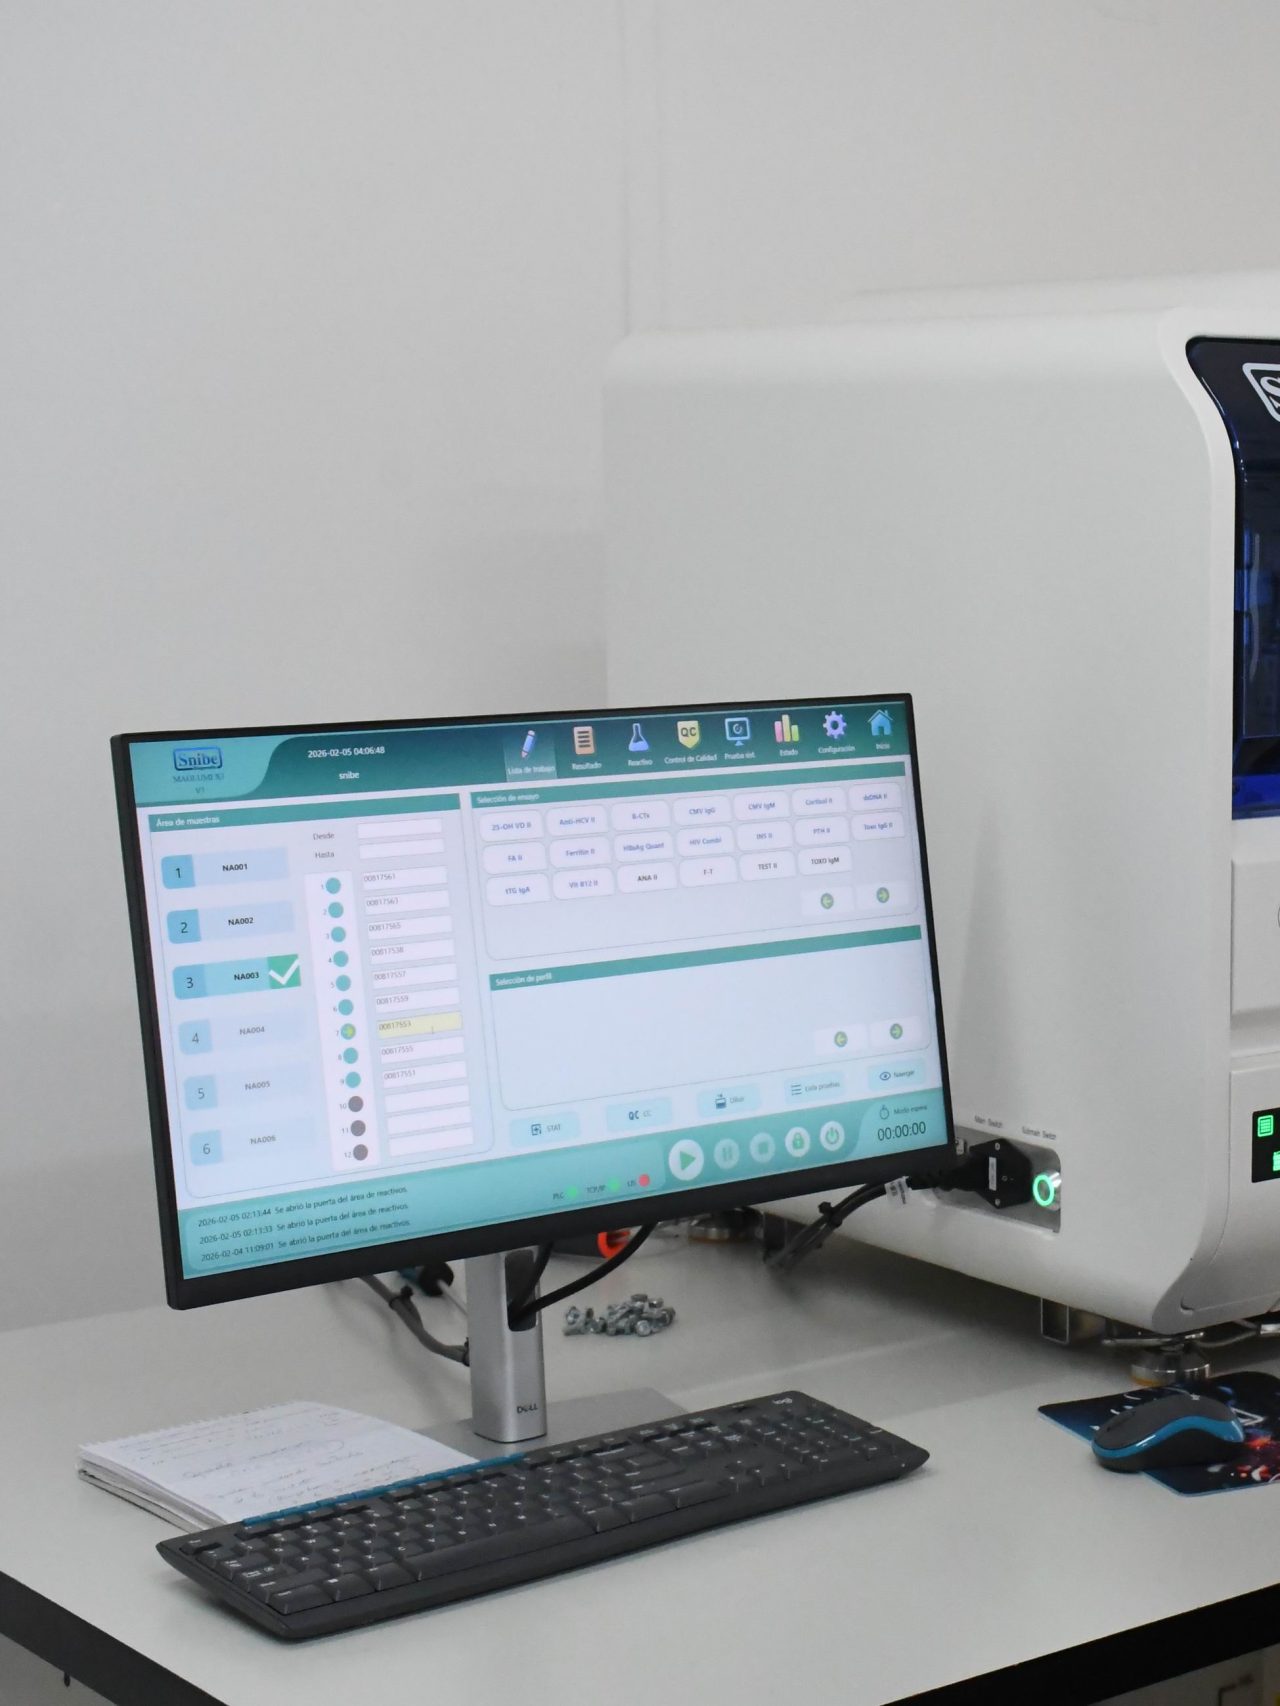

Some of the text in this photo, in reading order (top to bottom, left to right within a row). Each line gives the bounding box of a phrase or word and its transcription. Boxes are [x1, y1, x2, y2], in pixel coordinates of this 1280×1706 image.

[680, 727, 697, 737] QC
[308, 746, 385, 758] 2026-02-05 04:06:48
[178, 749, 219, 768] Snibe
[664, 756, 685, 764] Control
[695, 753, 718, 762] Calidad
[339, 770, 360, 780] snibe
[477, 794, 507, 804] Selección
[805, 797, 828, 806] Cortisol
[748, 802, 776, 811] CMV IgM
[156, 816, 220, 828] Área de muestras
[515, 822, 526, 830] VD
[559, 817, 590, 826] Anti-HCV
[313, 832, 335, 840] Desde
[689, 836, 722, 846] HIV Combi
[175, 863, 248, 878] 1 NA001
[758, 863, 772, 871] TEST
[363, 873, 396, 882] 00817561
[637, 874, 652, 882] ANA
[180, 917, 254, 934] 2 NA002
[186, 971, 260, 988] 3 NA003
[496, 976, 525, 986] Selección
[526, 975, 535, 983] de
[192, 1026, 265, 1043] 4 NA004
[198, 1080, 271, 1100] 5 NA005
[629, 1110, 640, 1121] QC
[547, 1124, 561, 1132] STAT
[877, 1121, 927, 1141] 00:00:00
[203, 1135, 277, 1155] 6 NA006
[198, 1213, 240, 1227] 2026-02-05
[275, 1205, 284, 1214] Se
[286, 1201, 304, 1212] abrió
[305, 1201, 312, 1209] la
[313, 1198, 336, 1209] puerta
[337, 1195, 349, 1203] del
[366, 1191, 375, 1199] de
[199, 1231, 241, 1245] 2026-02-05
[276, 1223, 286, 1231] Se
[287, 1219, 306, 1229] abrió
[307, 1218, 314, 1226] la
[315, 1214, 338, 1226] puerta
[339, 1211, 350, 1220] del
[368, 1208, 377, 1216] de
[201, 1248, 243, 1262] 2026-02-04
[278, 1240, 287, 1249] Se
[289, 1236, 307, 1246] abrió
[316, 1231, 340, 1242] puerta
[341, 1228, 352, 1237] del
[516, 1403, 538, 1414] DELL
